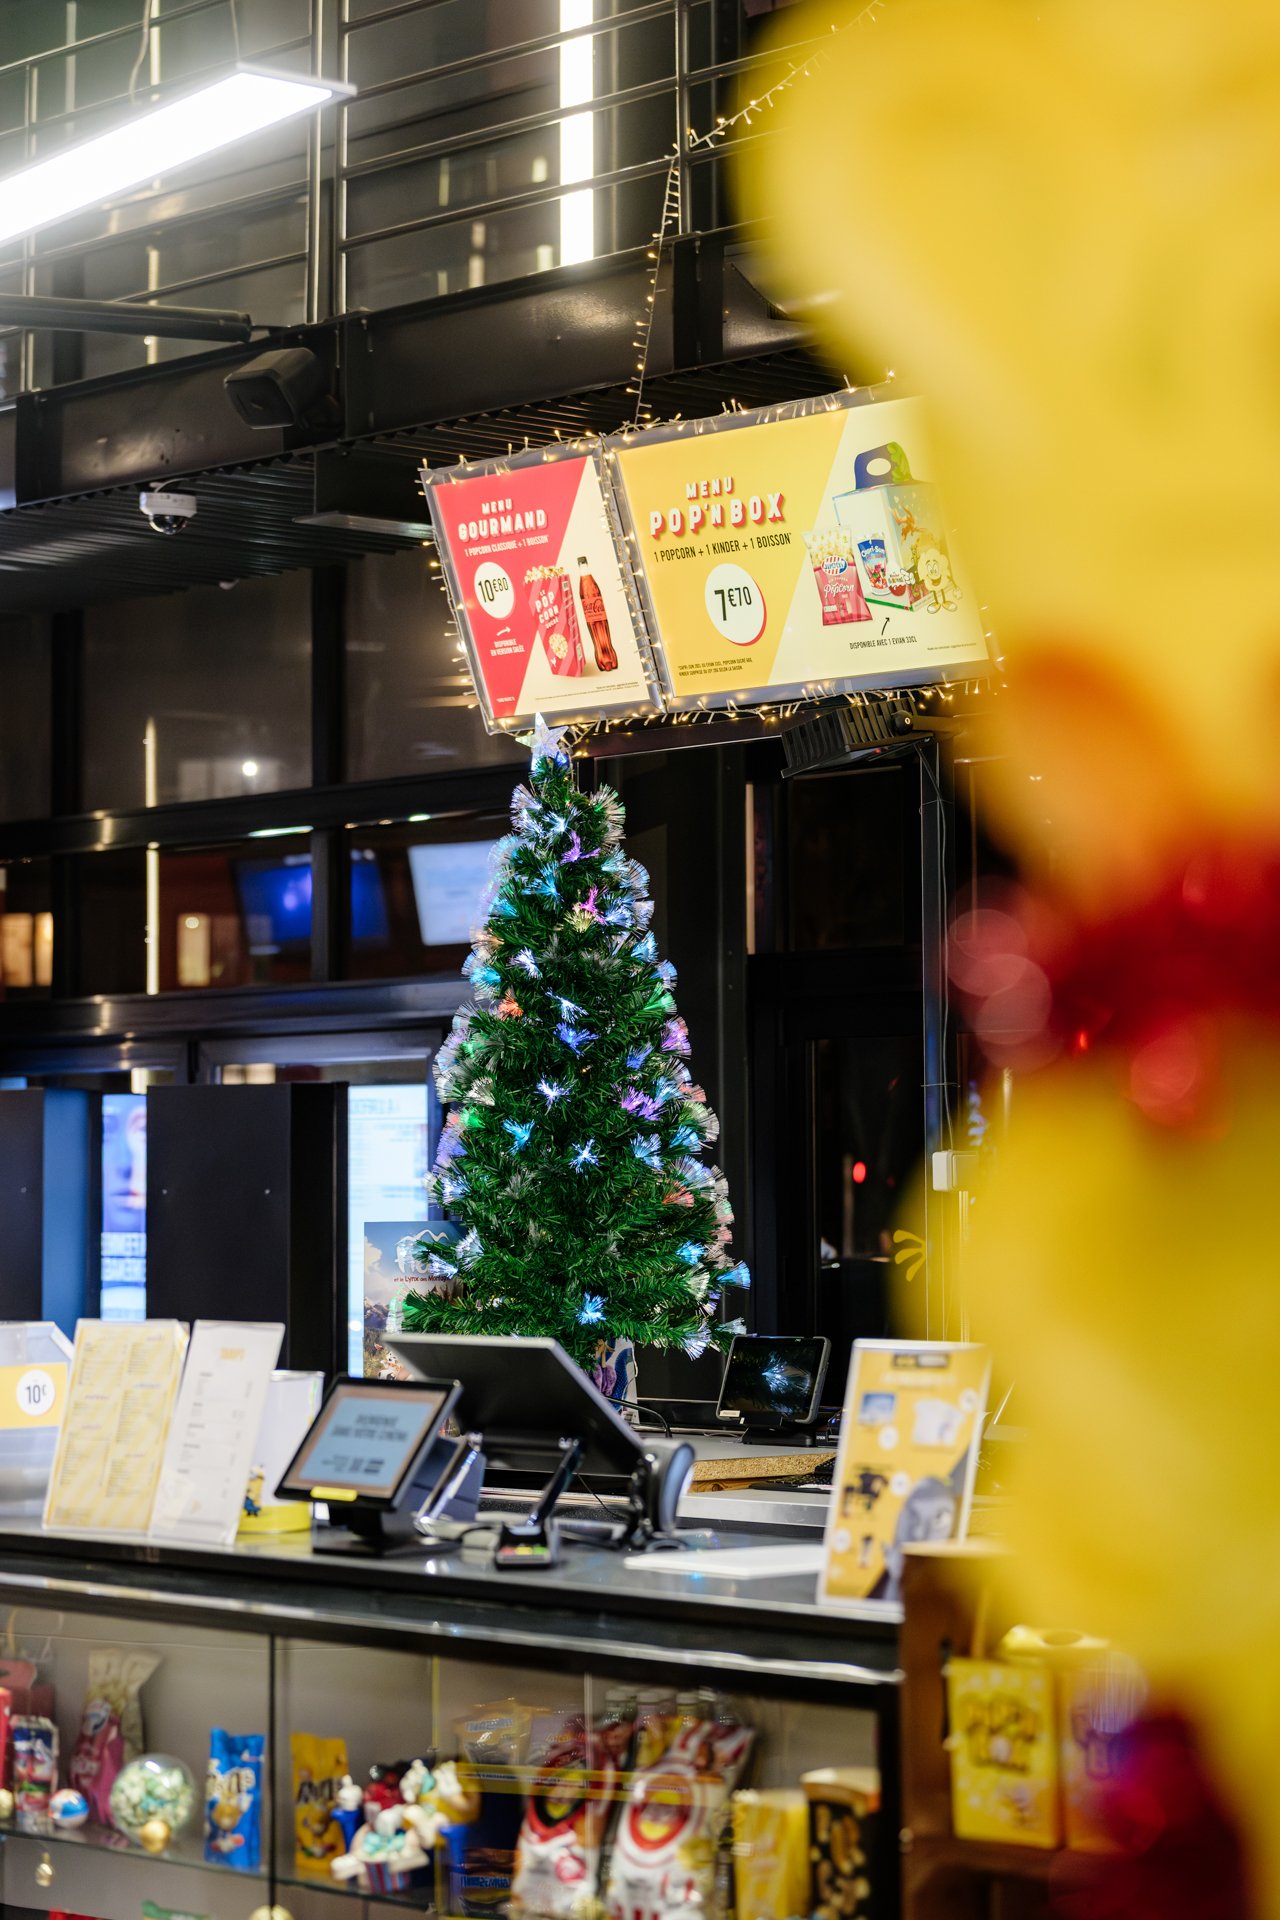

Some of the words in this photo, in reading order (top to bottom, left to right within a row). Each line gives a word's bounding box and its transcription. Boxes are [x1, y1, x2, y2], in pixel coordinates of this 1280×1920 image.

[686, 476, 734, 500] MENU
[482, 498, 512, 515] MENU
[458, 509, 548, 542] GOURMAND
[464, 549, 469, 557] 1
[468, 545, 492, 556] POPCORN
[491, 540, 518, 552] CLASSIQUE
[654, 551, 659, 562] 1
[660, 545, 696, 562] POPCORN
[698, 549, 704, 557] +
[706, 544, 710, 555] 1
[712, 540, 741, 555] KINDER
[743, 542, 748, 550] +
[750, 538, 755, 549] 1
[478, 577, 508, 603] 10€80
[538, 605, 559, 624] CORN
[714, 586, 752, 621] 7€70
[849, 640, 876, 650] DISPONIBLE
[876, 638, 888, 646] AVEC
[892, 636, 906, 645] EVIAN
